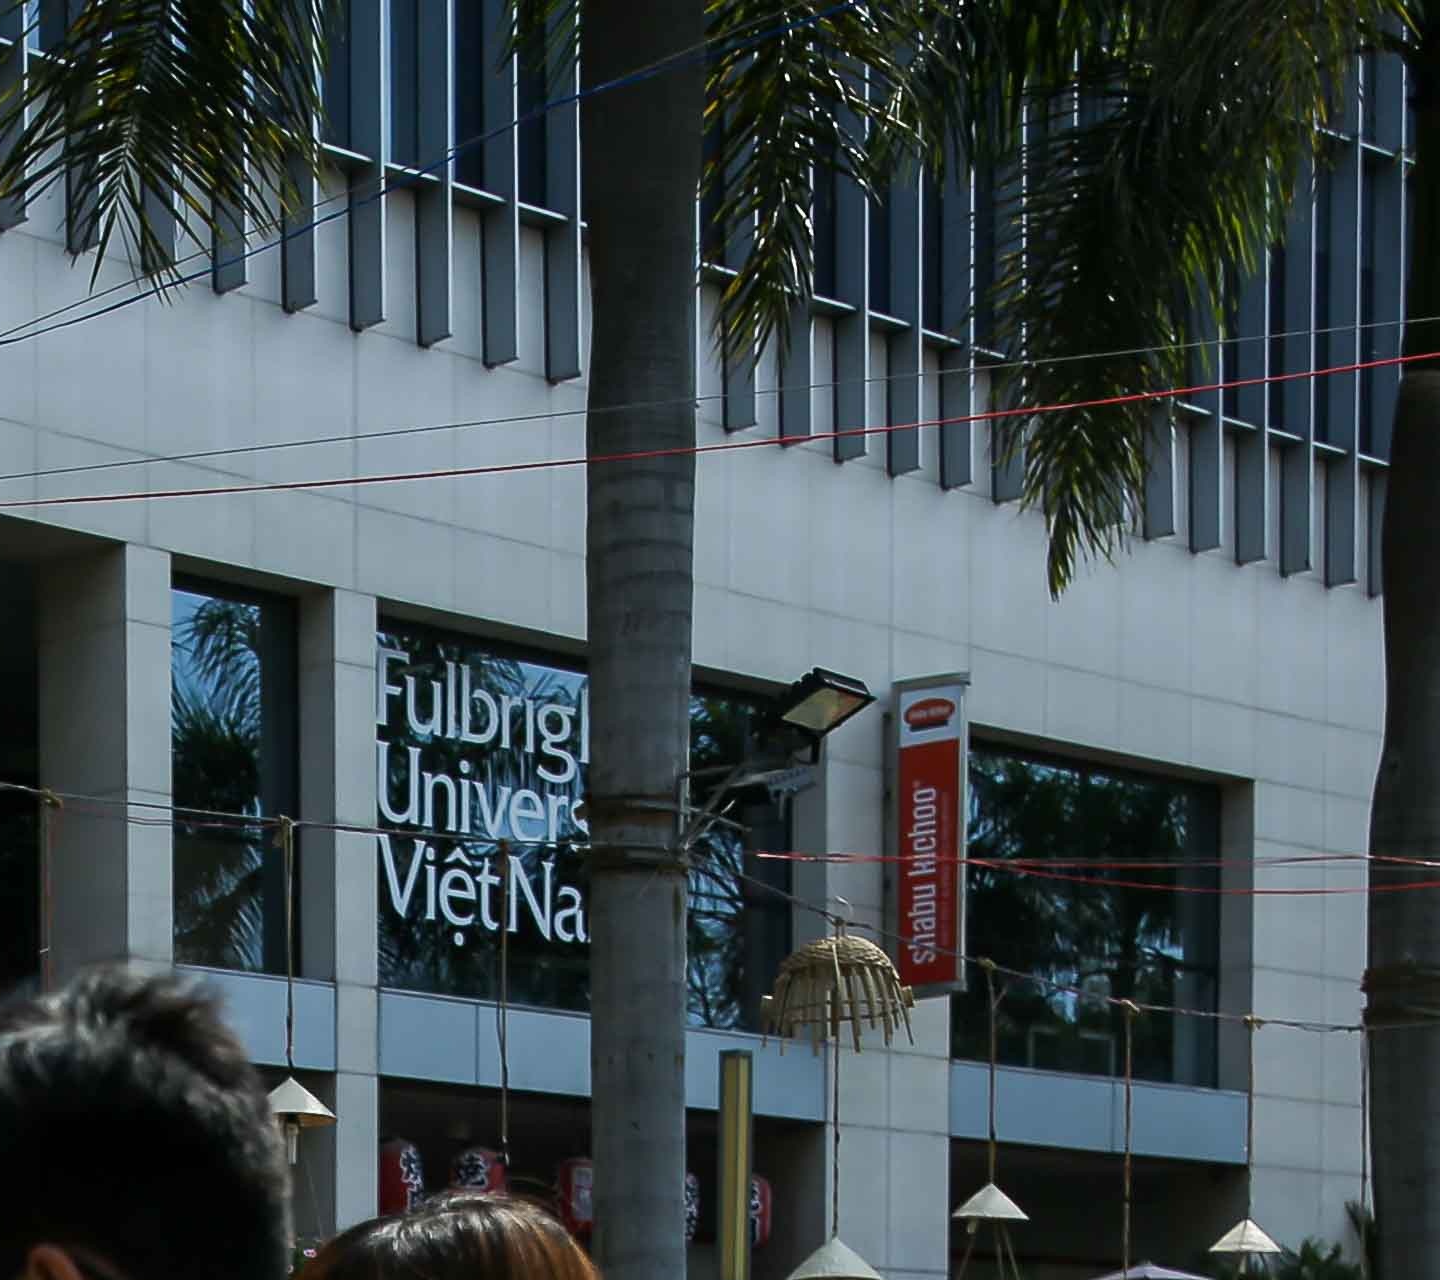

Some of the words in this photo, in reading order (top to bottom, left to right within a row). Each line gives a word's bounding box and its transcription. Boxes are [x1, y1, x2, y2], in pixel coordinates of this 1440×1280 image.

[376, 648, 590, 784] Fulbrig
[376, 739, 590, 851] Univers
[907, 787, 937, 877] kichoo
[505, 854, 591, 944] Na
[907, 884, 937, 966] shabu
